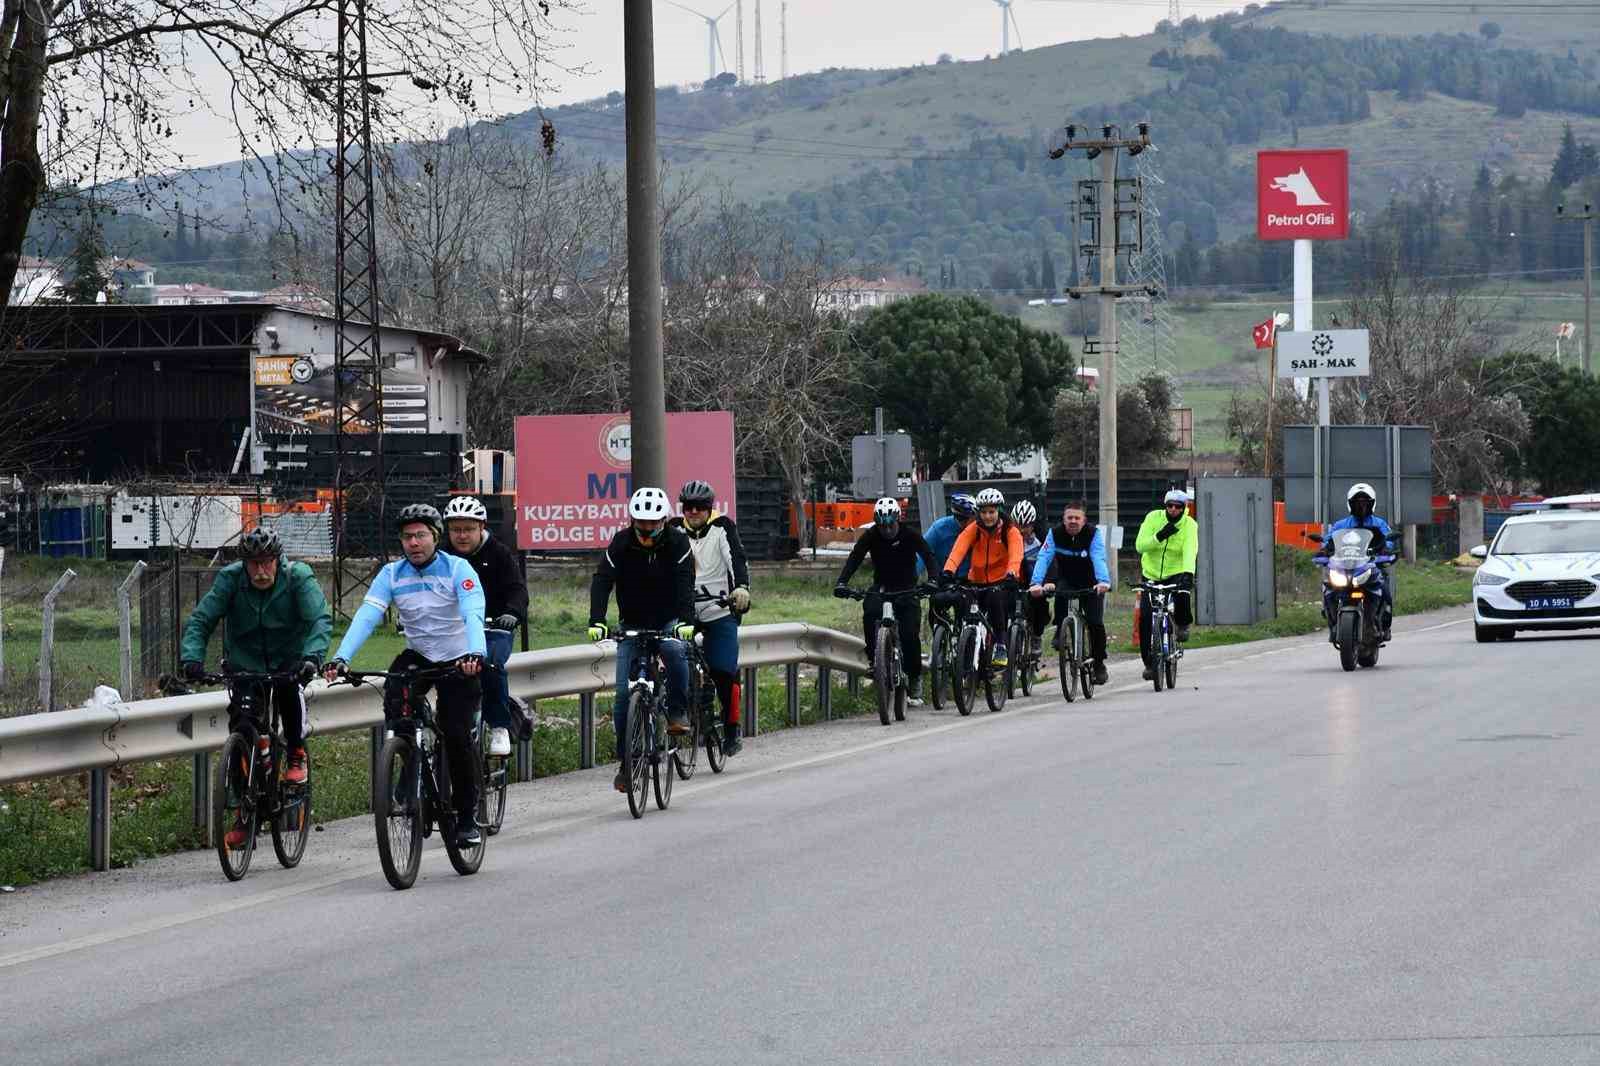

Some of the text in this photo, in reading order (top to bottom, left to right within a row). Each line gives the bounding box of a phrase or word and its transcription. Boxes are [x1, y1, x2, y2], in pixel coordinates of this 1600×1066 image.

[1267, 213, 1335, 226] Petrol Ofisi
[1327, 358, 1357, 368] MAK
[587, 472, 632, 500] MT
[524, 503, 628, 521] KUZEYBATI
[531, 523, 595, 543] BÖLGE
[1529, 599, 1540, 608] 10
[1542, 599, 1549, 607] A
